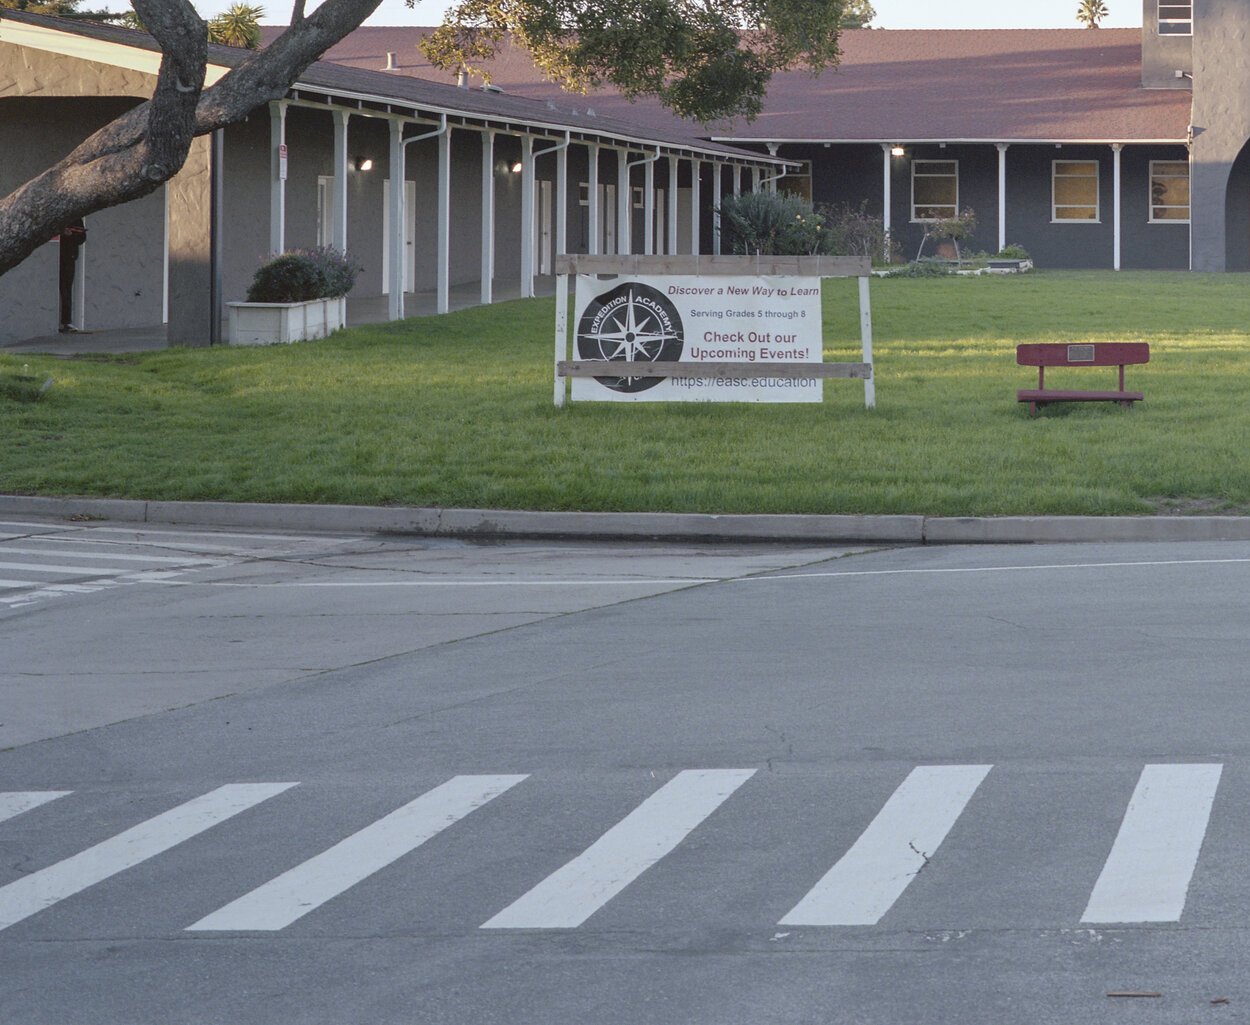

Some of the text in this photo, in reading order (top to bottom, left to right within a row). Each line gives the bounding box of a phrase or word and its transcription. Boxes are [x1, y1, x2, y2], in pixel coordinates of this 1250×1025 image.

[668, 285, 819, 298] Discover a New Way to Learn
[590, 295, 627, 334] EXPEDITION
[635, 295, 674, 332] ACADEMY
[690, 309, 806, 320] Serving Grades 5 through 8
[703, 331, 797, 343] Check Out our
[690, 347, 809, 362] Upcoming Events!
